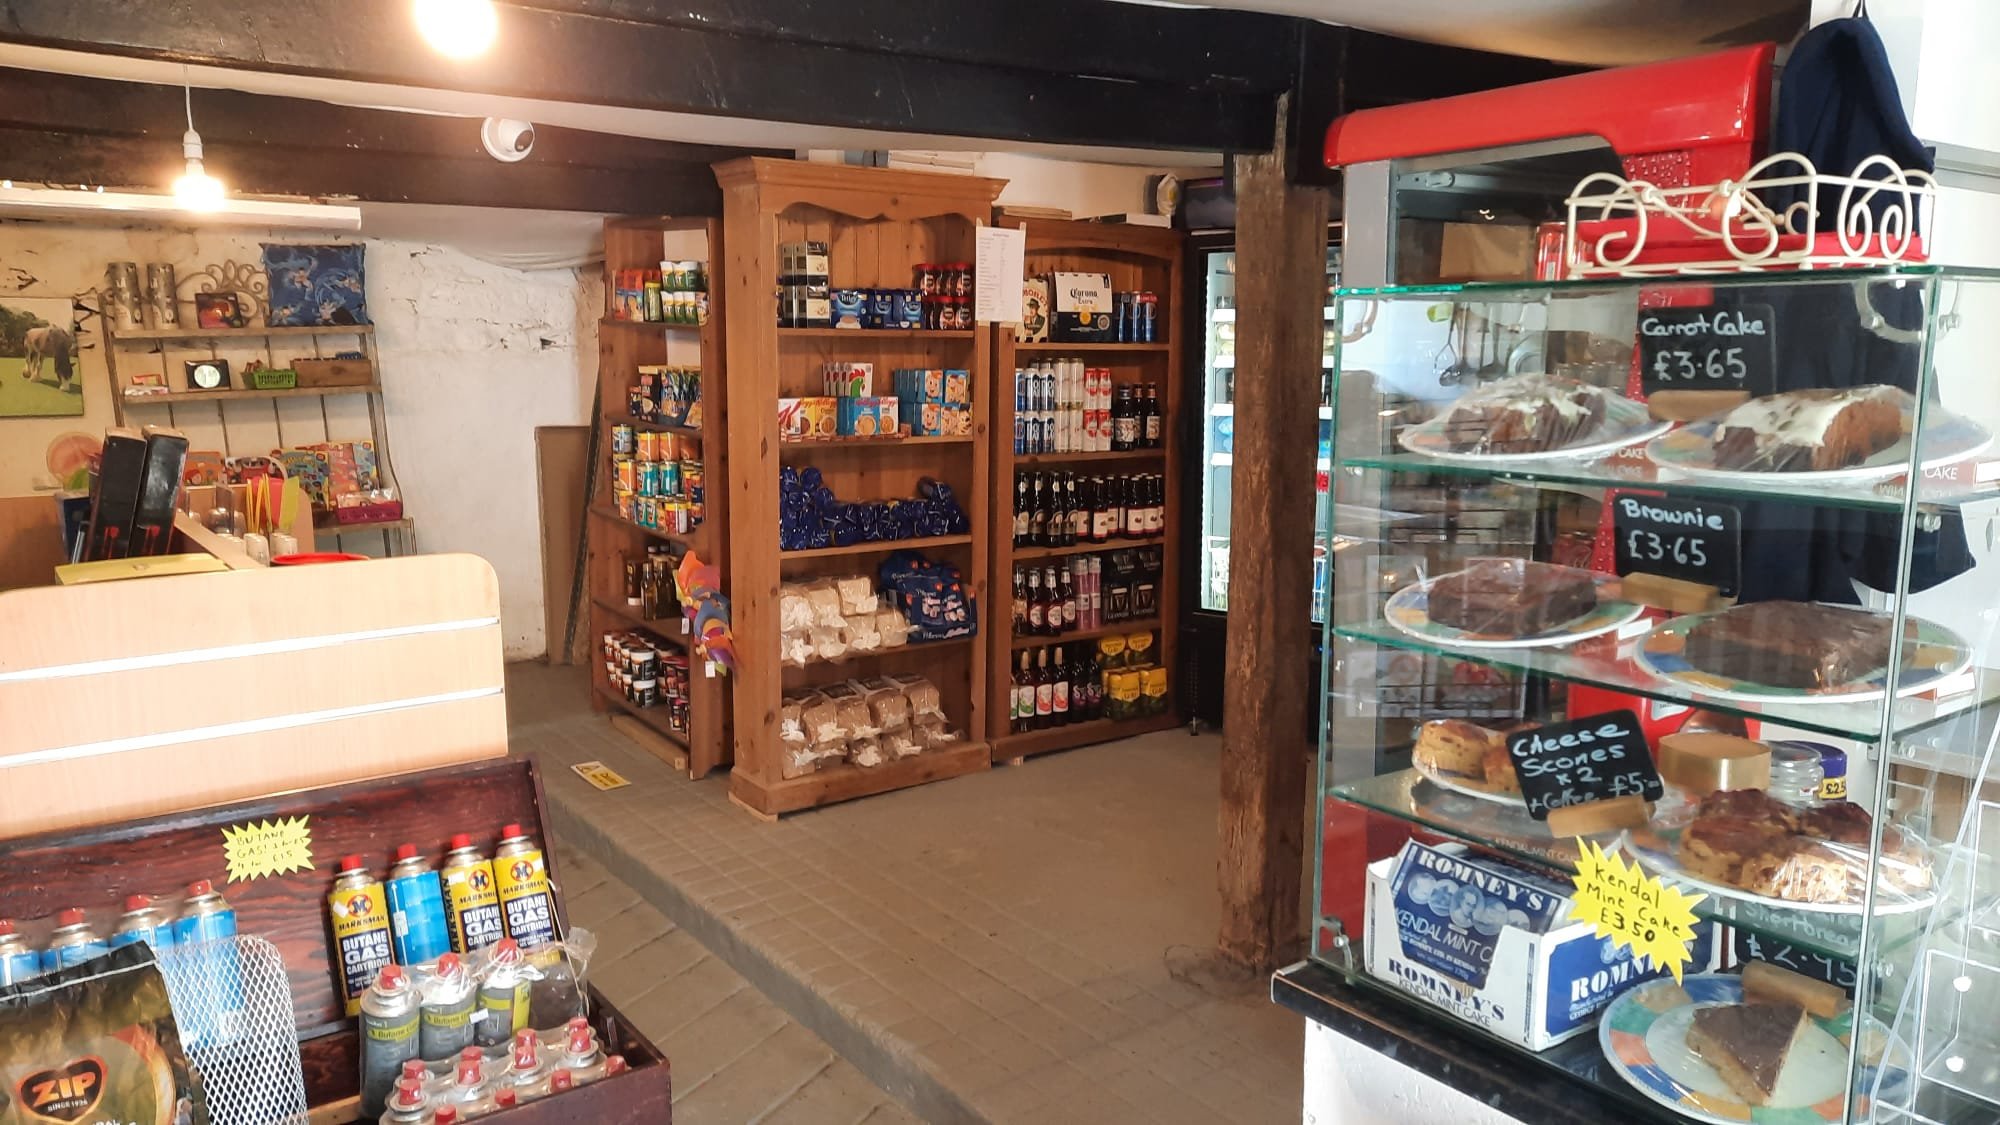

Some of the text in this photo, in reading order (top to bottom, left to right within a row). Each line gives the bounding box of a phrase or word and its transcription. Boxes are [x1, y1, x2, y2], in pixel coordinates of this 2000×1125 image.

[1070, 287, 1098, 299] Corona
[1641, 311, 1766, 336] Carrot Cake
[1924, 467, 1958, 480] CAKE
[1620, 500, 1724, 530] Brownie
[1512, 723, 1630, 757] Cheese
[1521, 744, 1626, 777] Scones
[1576, 766, 1602, 782] 2
[1418, 849, 1545, 911] ROMNEY'S
[1595, 862, 1660, 910] Kendal
[506, 895, 548, 915] BUTANE
[509, 907, 550, 927] GAS
[1586, 882, 1681, 938] Mint Cake
[339, 914, 385, 931] MARKSMAN
[466, 918, 503, 937] GAS
[342, 930, 388, 952] BUTANE
[1442, 931, 1482, 957] MINT
[344, 943, 390, 965] GAS
[1389, 956, 1504, 1020] ROMNEY'S
[1400, 979, 1492, 1027] KENDAL MINT CAKE
[31, 1071, 97, 1108] ZIP
[47, 1100, 70, 1112] SINCE
